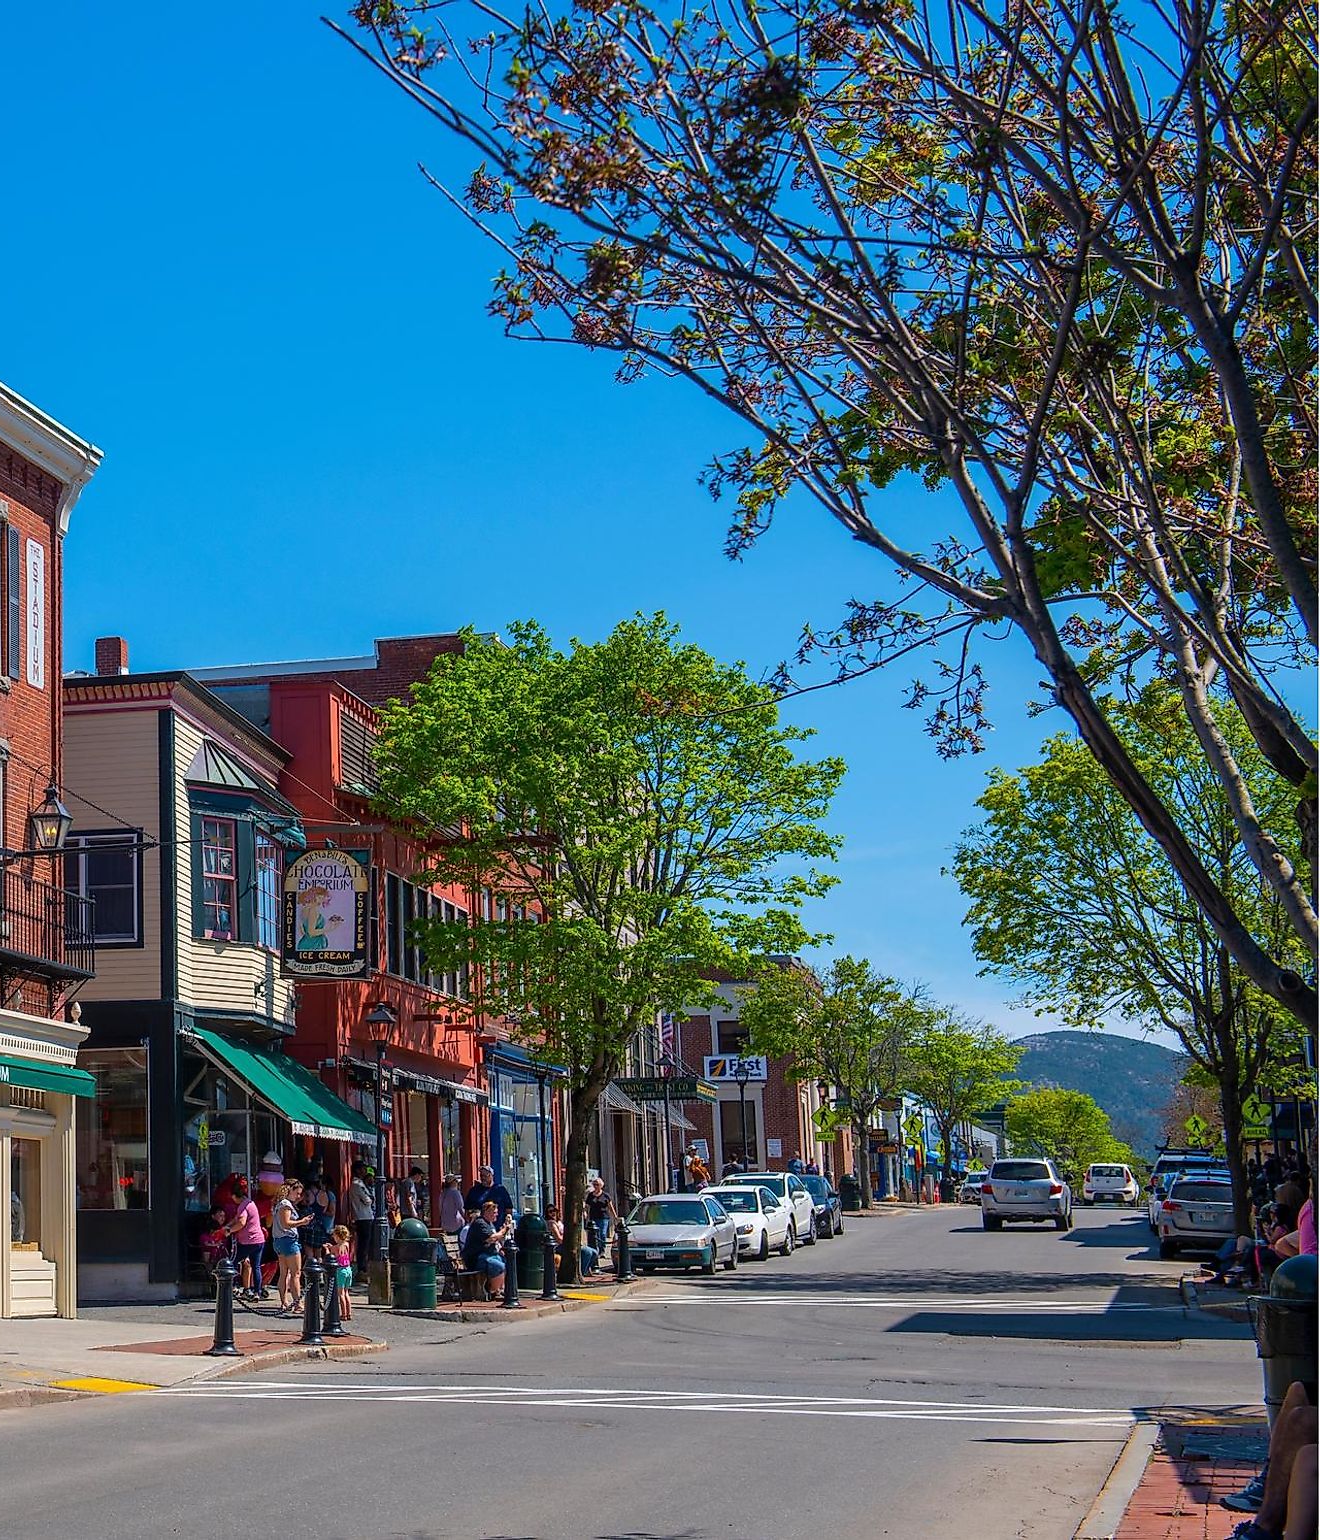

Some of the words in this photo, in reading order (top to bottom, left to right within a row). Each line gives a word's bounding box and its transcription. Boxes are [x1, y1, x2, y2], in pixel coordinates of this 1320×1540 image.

[286, 865, 368, 878] CHOCOLATE
[298, 879, 354, 891] EMPORIUM
[299, 951, 313, 960] ICE
[318, 951, 351, 960] CREAM
[294, 963, 313, 972] MADE
[314, 963, 335, 973] FRESH
[729, 1059, 761, 1071] First
